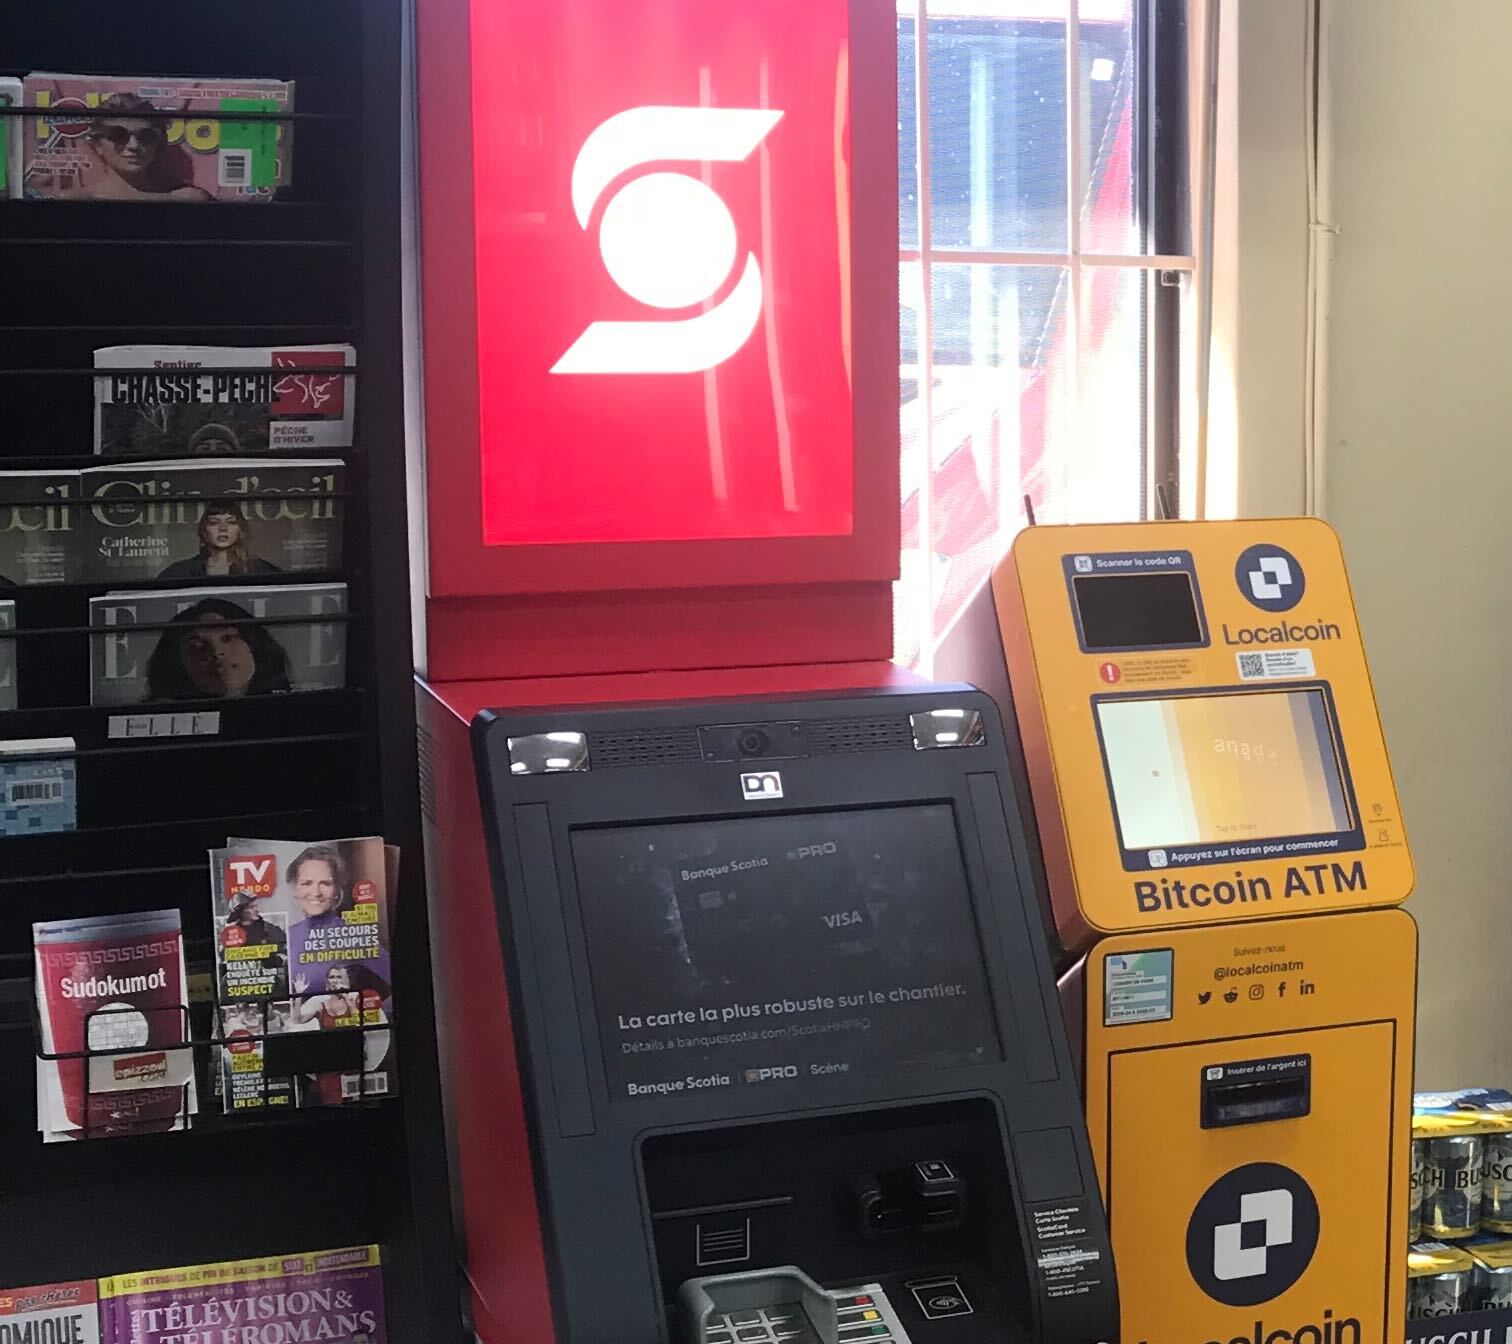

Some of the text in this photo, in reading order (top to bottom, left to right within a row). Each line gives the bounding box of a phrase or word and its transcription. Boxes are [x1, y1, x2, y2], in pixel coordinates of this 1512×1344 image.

[1096, 556, 1182, 569] Scanner le code QR
[1222, 618, 1341, 646] Localcoin
[681, 841, 837, 881] Banque Scotia PRO
[1171, 850, 1213, 863] Appuyez
[1214, 848, 1229, 858] sur
[1263, 844, 1284, 856] pour
[1285, 838, 1339, 853] commencer
[230, 860, 271, 885] TV
[1133, 860, 1368, 913] Bitcoin ATM
[309, 924, 379, 939] AU SECOURS
[822, 910, 863, 929] VISA
[305, 935, 379, 951] DES COUPLES
[300, 952, 314, 964] EN
[1214, 960, 1304, 981] @localcoinatm
[61, 968, 167, 999] Sudokumot
[228, 984, 272, 996] SUSPECT
[618, 983, 967, 1031] La carte la plus robuste sur le chantier.
[1256, 1063, 1266, 1073] de
[1297, 1058, 1307, 1068] ici
[628, 1079, 684, 1097] Banque
[686, 1073, 731, 1090] Scotia
[141, 1287, 331, 1333] TÉLÉVISION
